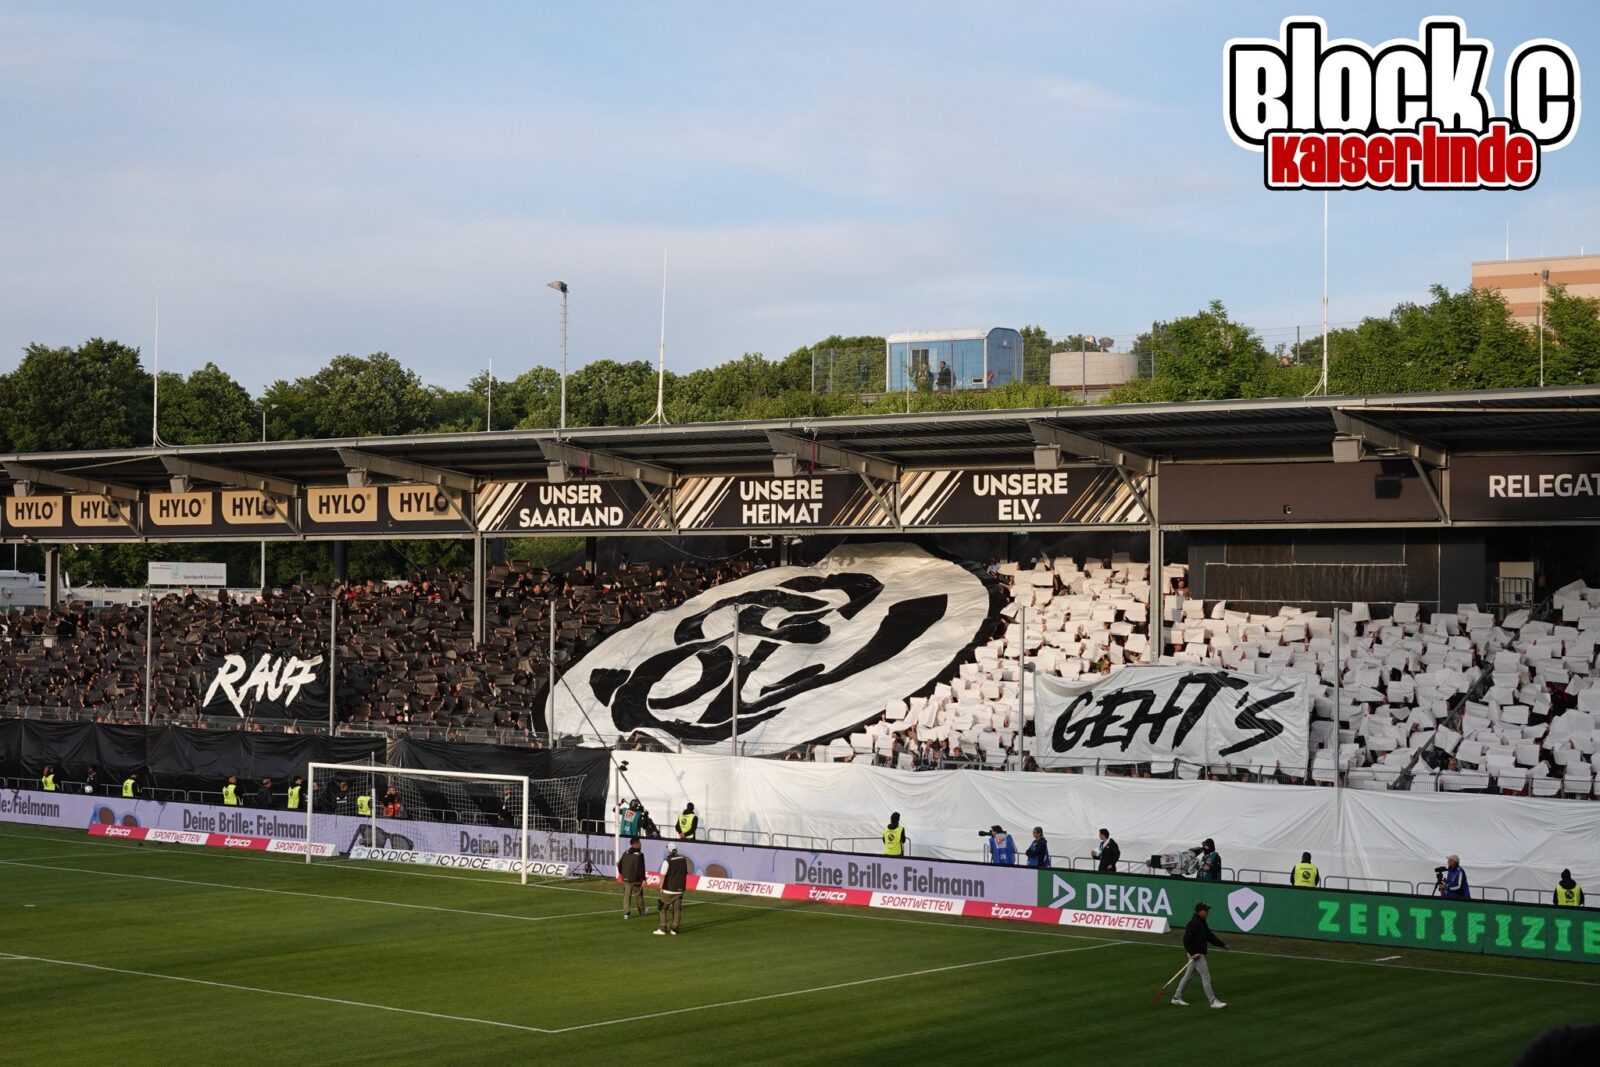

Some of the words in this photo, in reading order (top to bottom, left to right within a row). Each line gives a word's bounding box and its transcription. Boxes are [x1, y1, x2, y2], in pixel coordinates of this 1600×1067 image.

[539, 484, 602, 505] UNSER
[739, 479, 824, 500] UNSERE
[973, 472, 1068, 496] UNSERE
[519, 506, 624, 528] SAARLAND
[742, 502, 823, 524] HEIMAT
[998, 498, 1042, 522] ELV.
[202, 652, 324, 719] RAUF
[1051, 671, 1296, 757] GEHT'S
[13, 794, 60, 818] Fielmann
[105, 825, 132, 837] tipico
[183, 808, 216, 832] Deine
[218, 811, 254, 835] Brille:
[152, 830, 201, 843] SPORTWETTEN
[223, 835, 252, 848] tipico
[459, 830, 499, 857] Deine
[503, 833, 545, 860] Brile:
[366, 849, 419, 864] ICYDICE
[436, 854, 491, 870] ICYDICE
[706, 879, 775, 896] SPORTWETTEN
[795, 857, 843, 886] Deine
[847, 861, 898, 891] Brille:
[903, 865, 985, 898] Fielmann
[808, 886, 847, 902] tipico
[880, 895, 954, 912] SPORTWETTEN
[1086, 882, 1174, 917] DEKRA
[990, 903, 1033, 920] tipico
[1071, 912, 1155, 930] SPORTWETTEN
